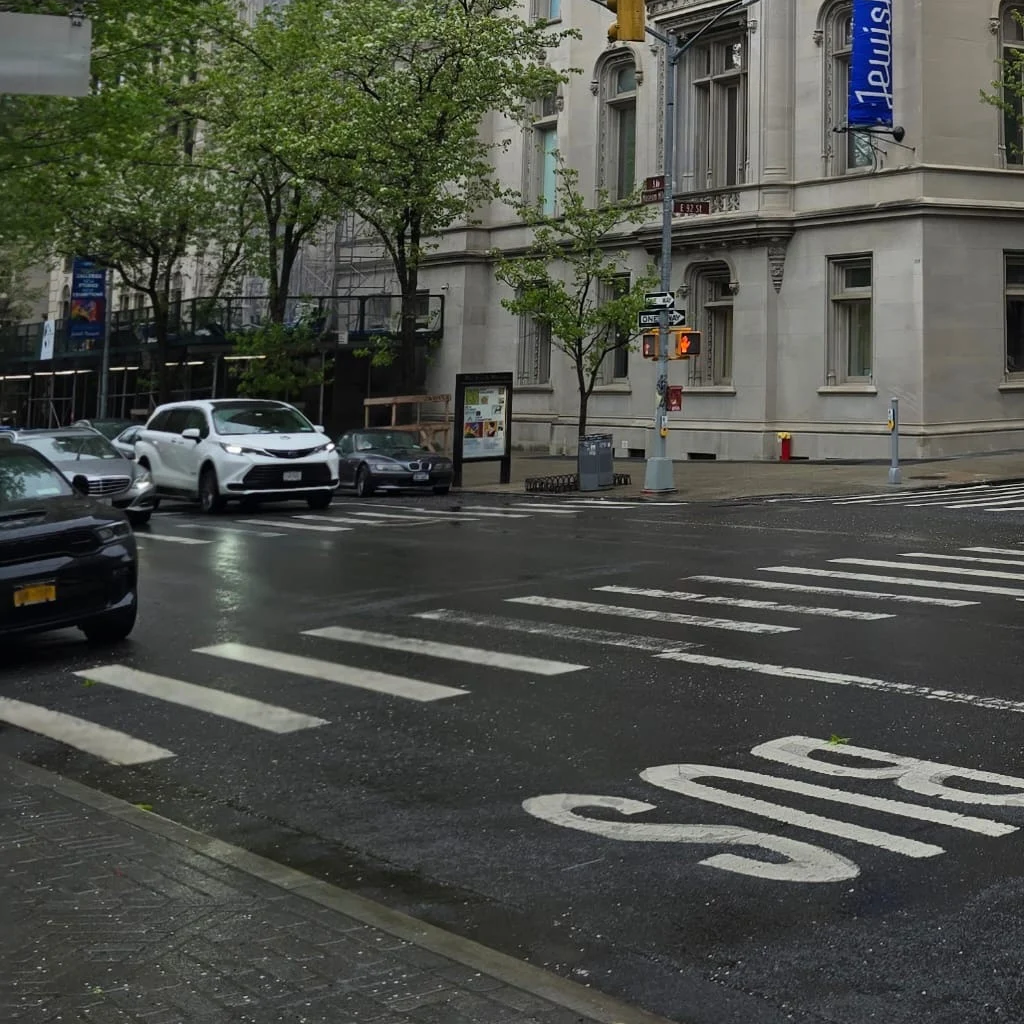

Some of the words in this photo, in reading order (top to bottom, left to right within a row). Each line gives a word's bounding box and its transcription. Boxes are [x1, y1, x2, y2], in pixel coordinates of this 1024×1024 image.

[680, 203, 684, 212] E
[686, 203, 694, 213] 92
[642, 315, 660, 323] ONE
